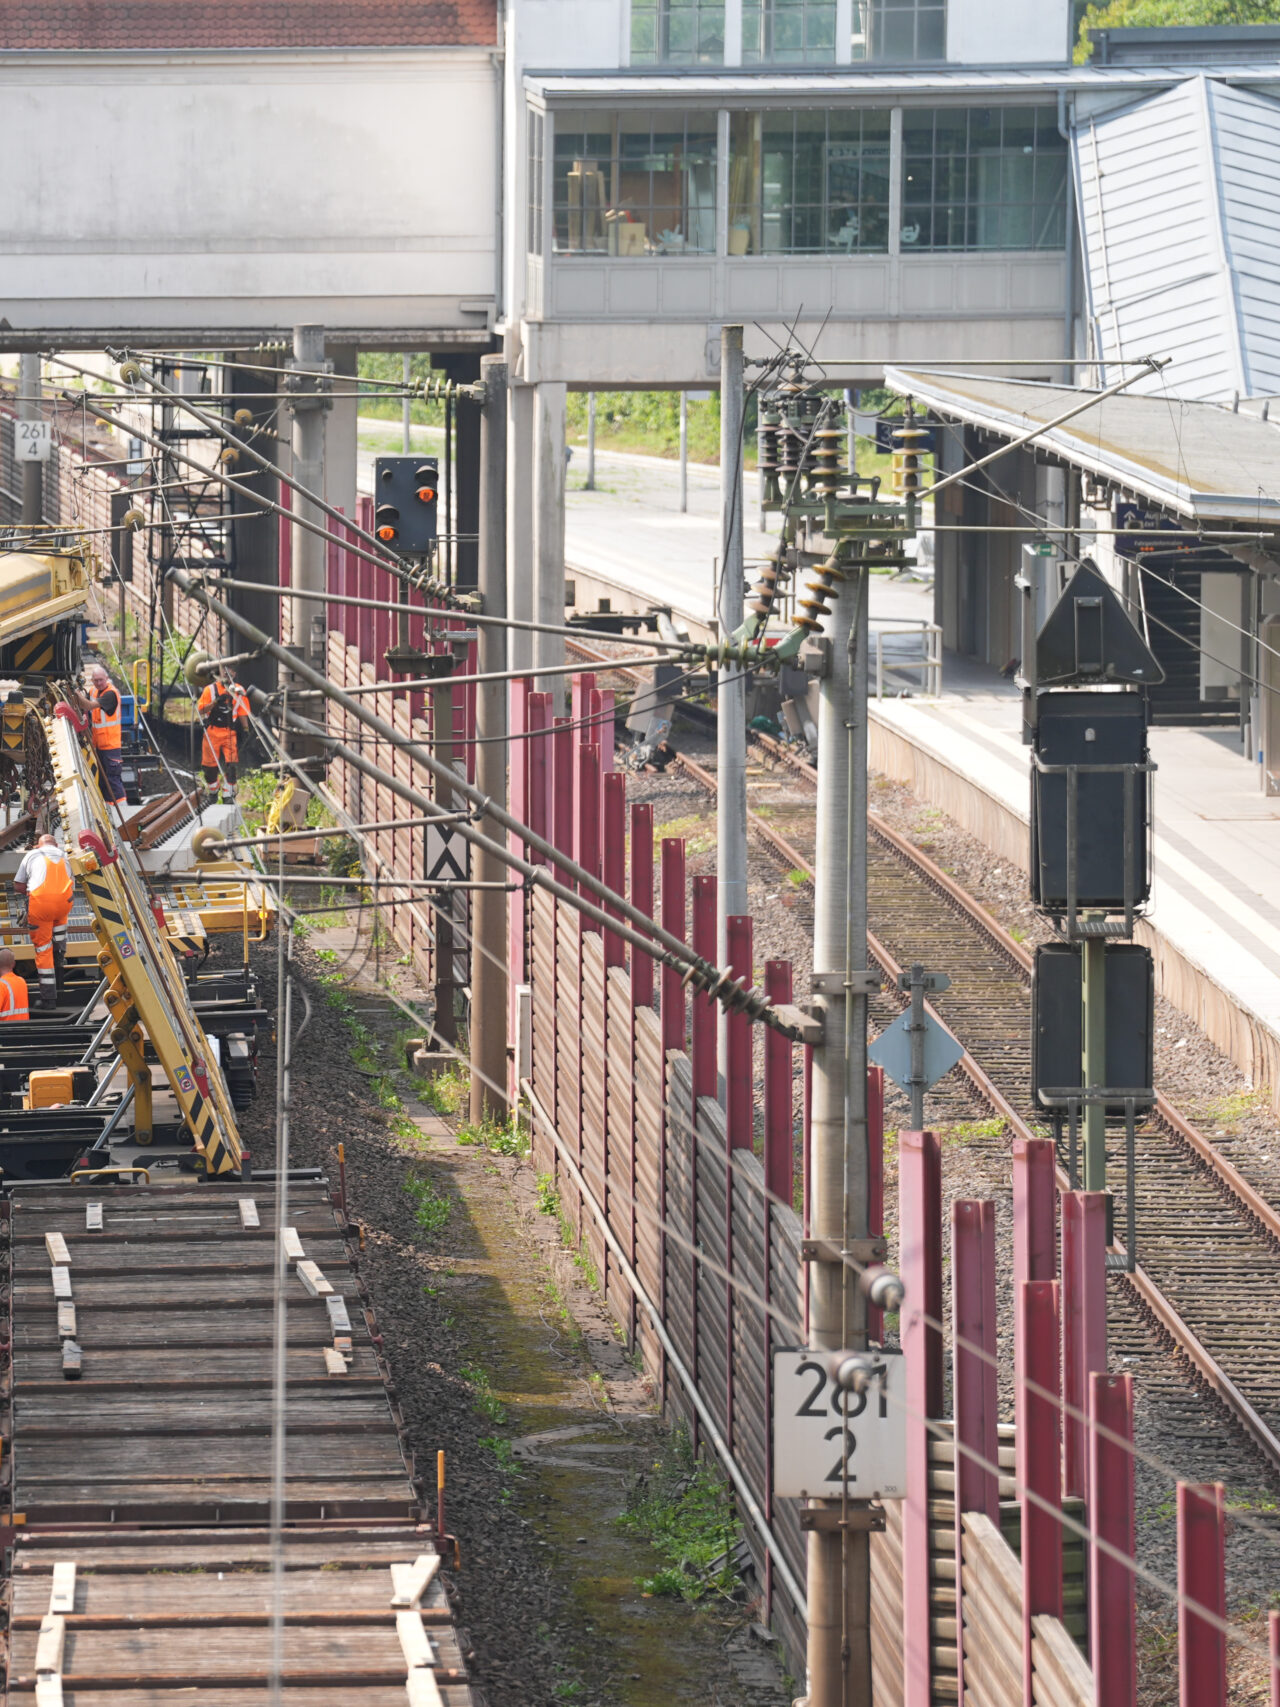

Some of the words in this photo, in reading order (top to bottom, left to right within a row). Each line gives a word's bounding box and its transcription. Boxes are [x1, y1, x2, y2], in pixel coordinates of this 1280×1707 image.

[20, 423, 46, 439] 261
[28, 441, 38, 456] 4
[824, 1426, 857, 1482] 2
